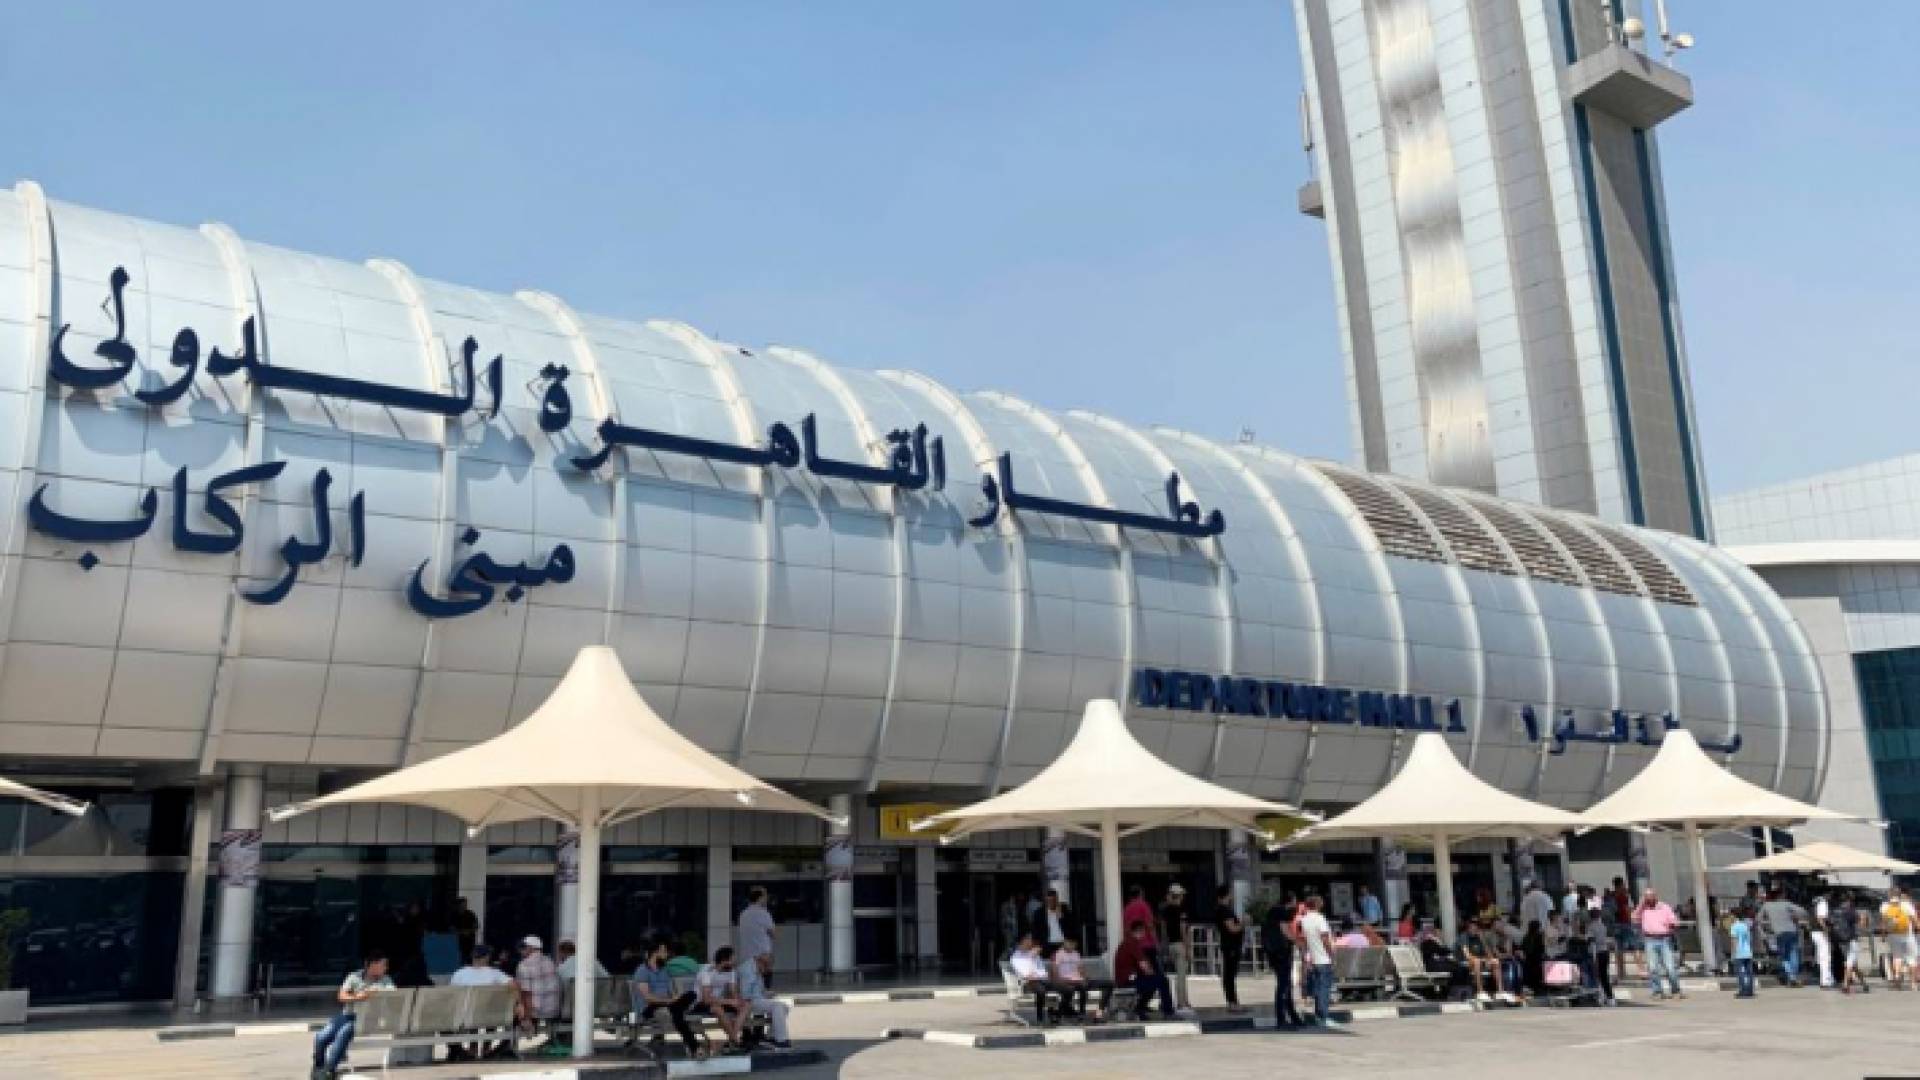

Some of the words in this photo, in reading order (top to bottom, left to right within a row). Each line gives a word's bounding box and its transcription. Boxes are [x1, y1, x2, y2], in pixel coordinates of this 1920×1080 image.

[540, 362, 946, 491] القاهرة
[29, 459, 366, 605] الركاب
[969, 451, 1225, 537] مطار
[1134, 667, 1354, 723] DEPARTURE
[1358, 690, 1443, 730] HALL
[1446, 699, 1466, 732] 1
